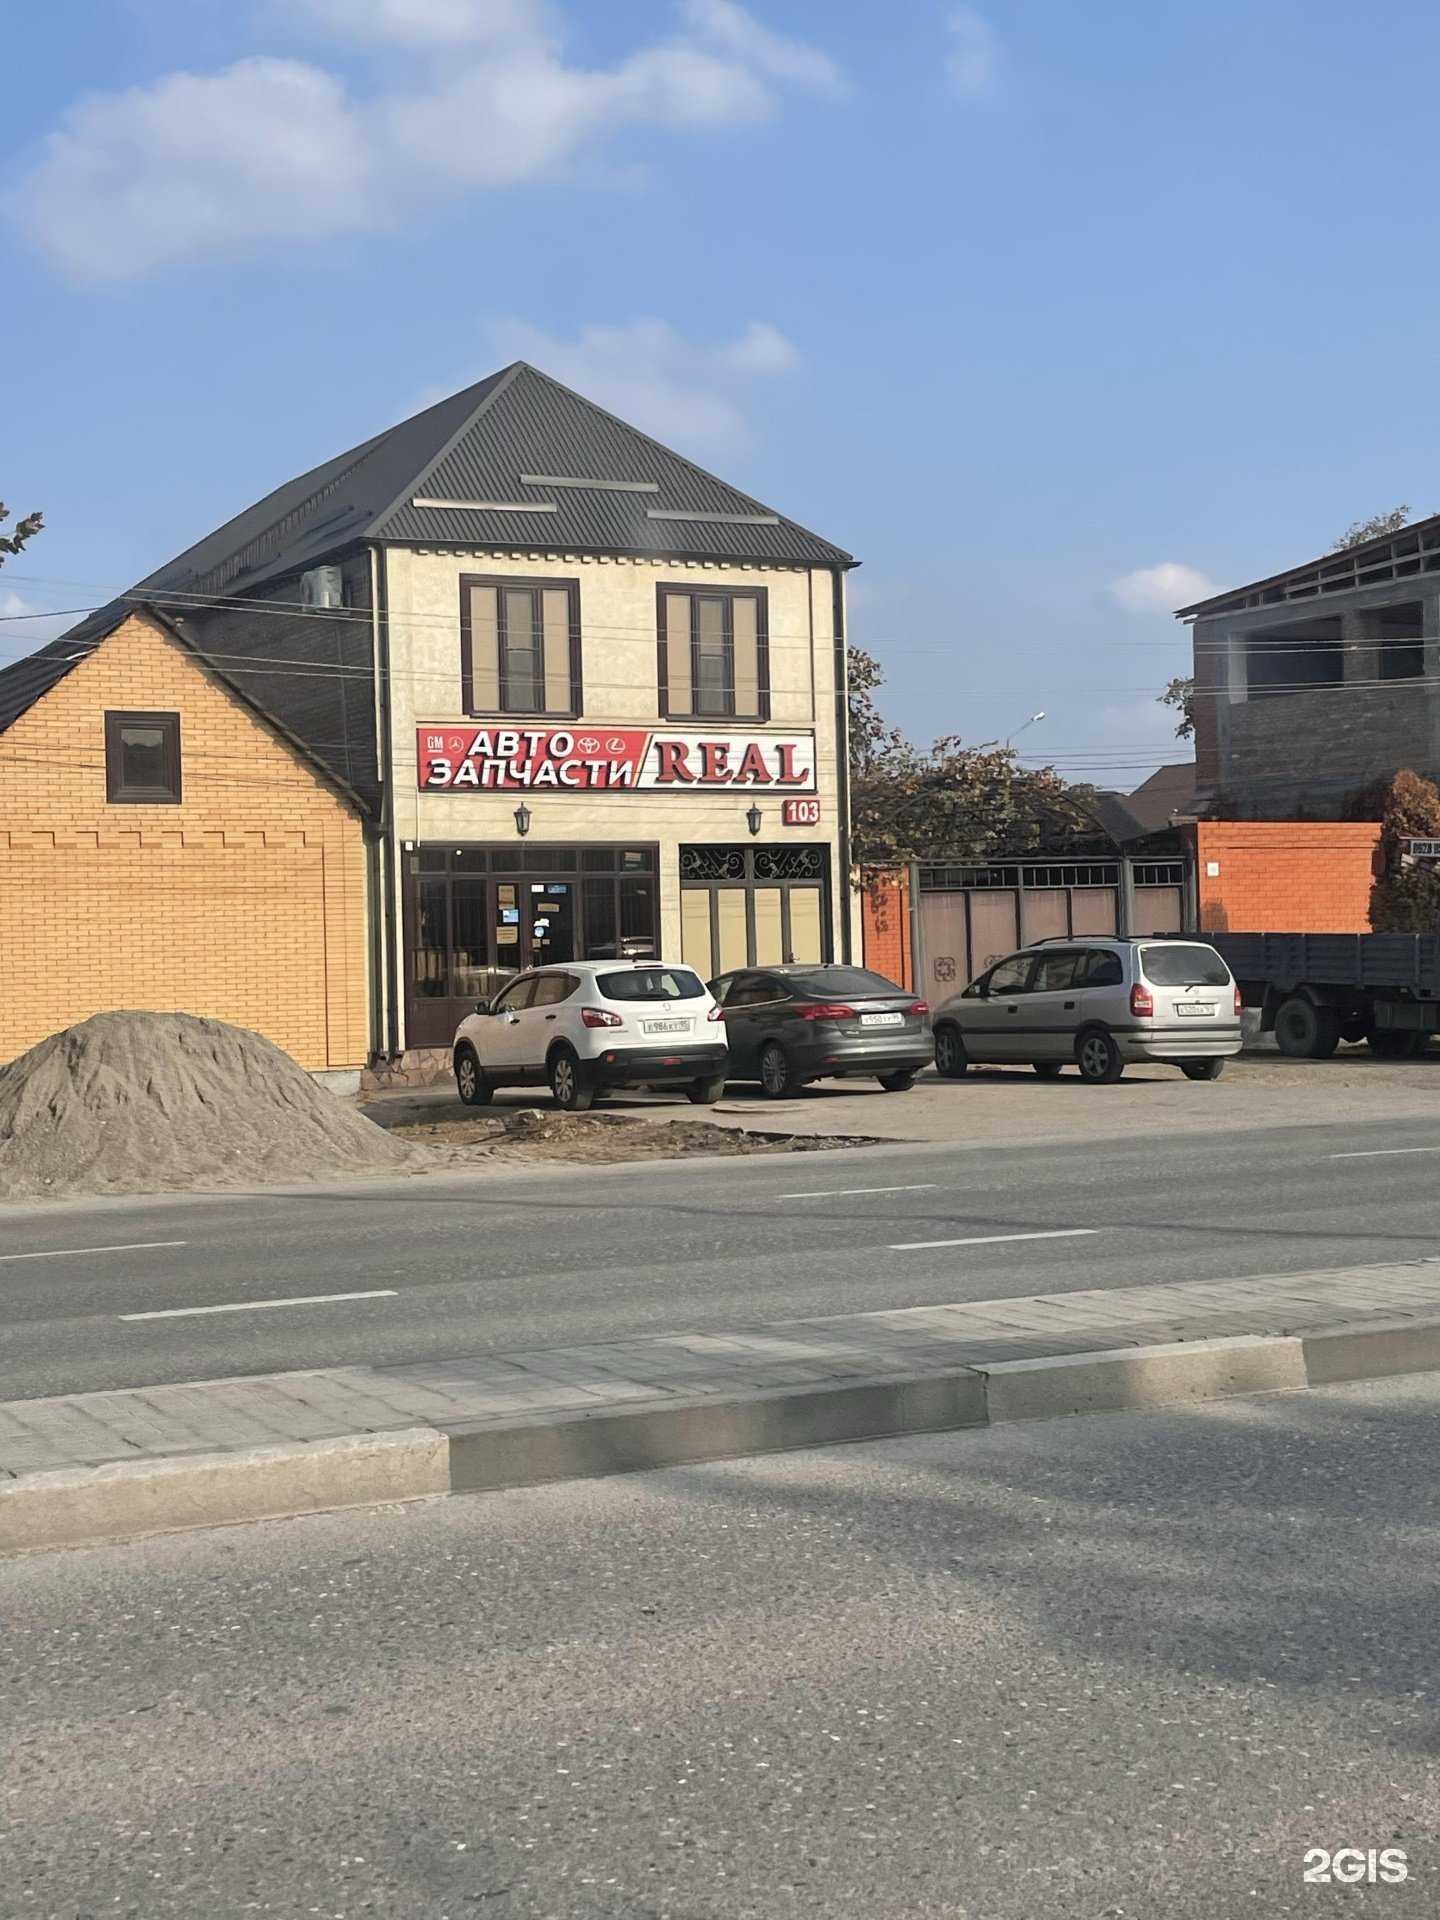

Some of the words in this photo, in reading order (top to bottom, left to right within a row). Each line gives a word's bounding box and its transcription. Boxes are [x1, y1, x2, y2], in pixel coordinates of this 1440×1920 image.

[427, 735, 444, 753] GM
[467, 730, 575, 757] АВТО
[427, 758, 634, 785] ЗАПЧАСТИ
[654, 741, 809, 785] REAL
[788, 801, 819, 822] 103
